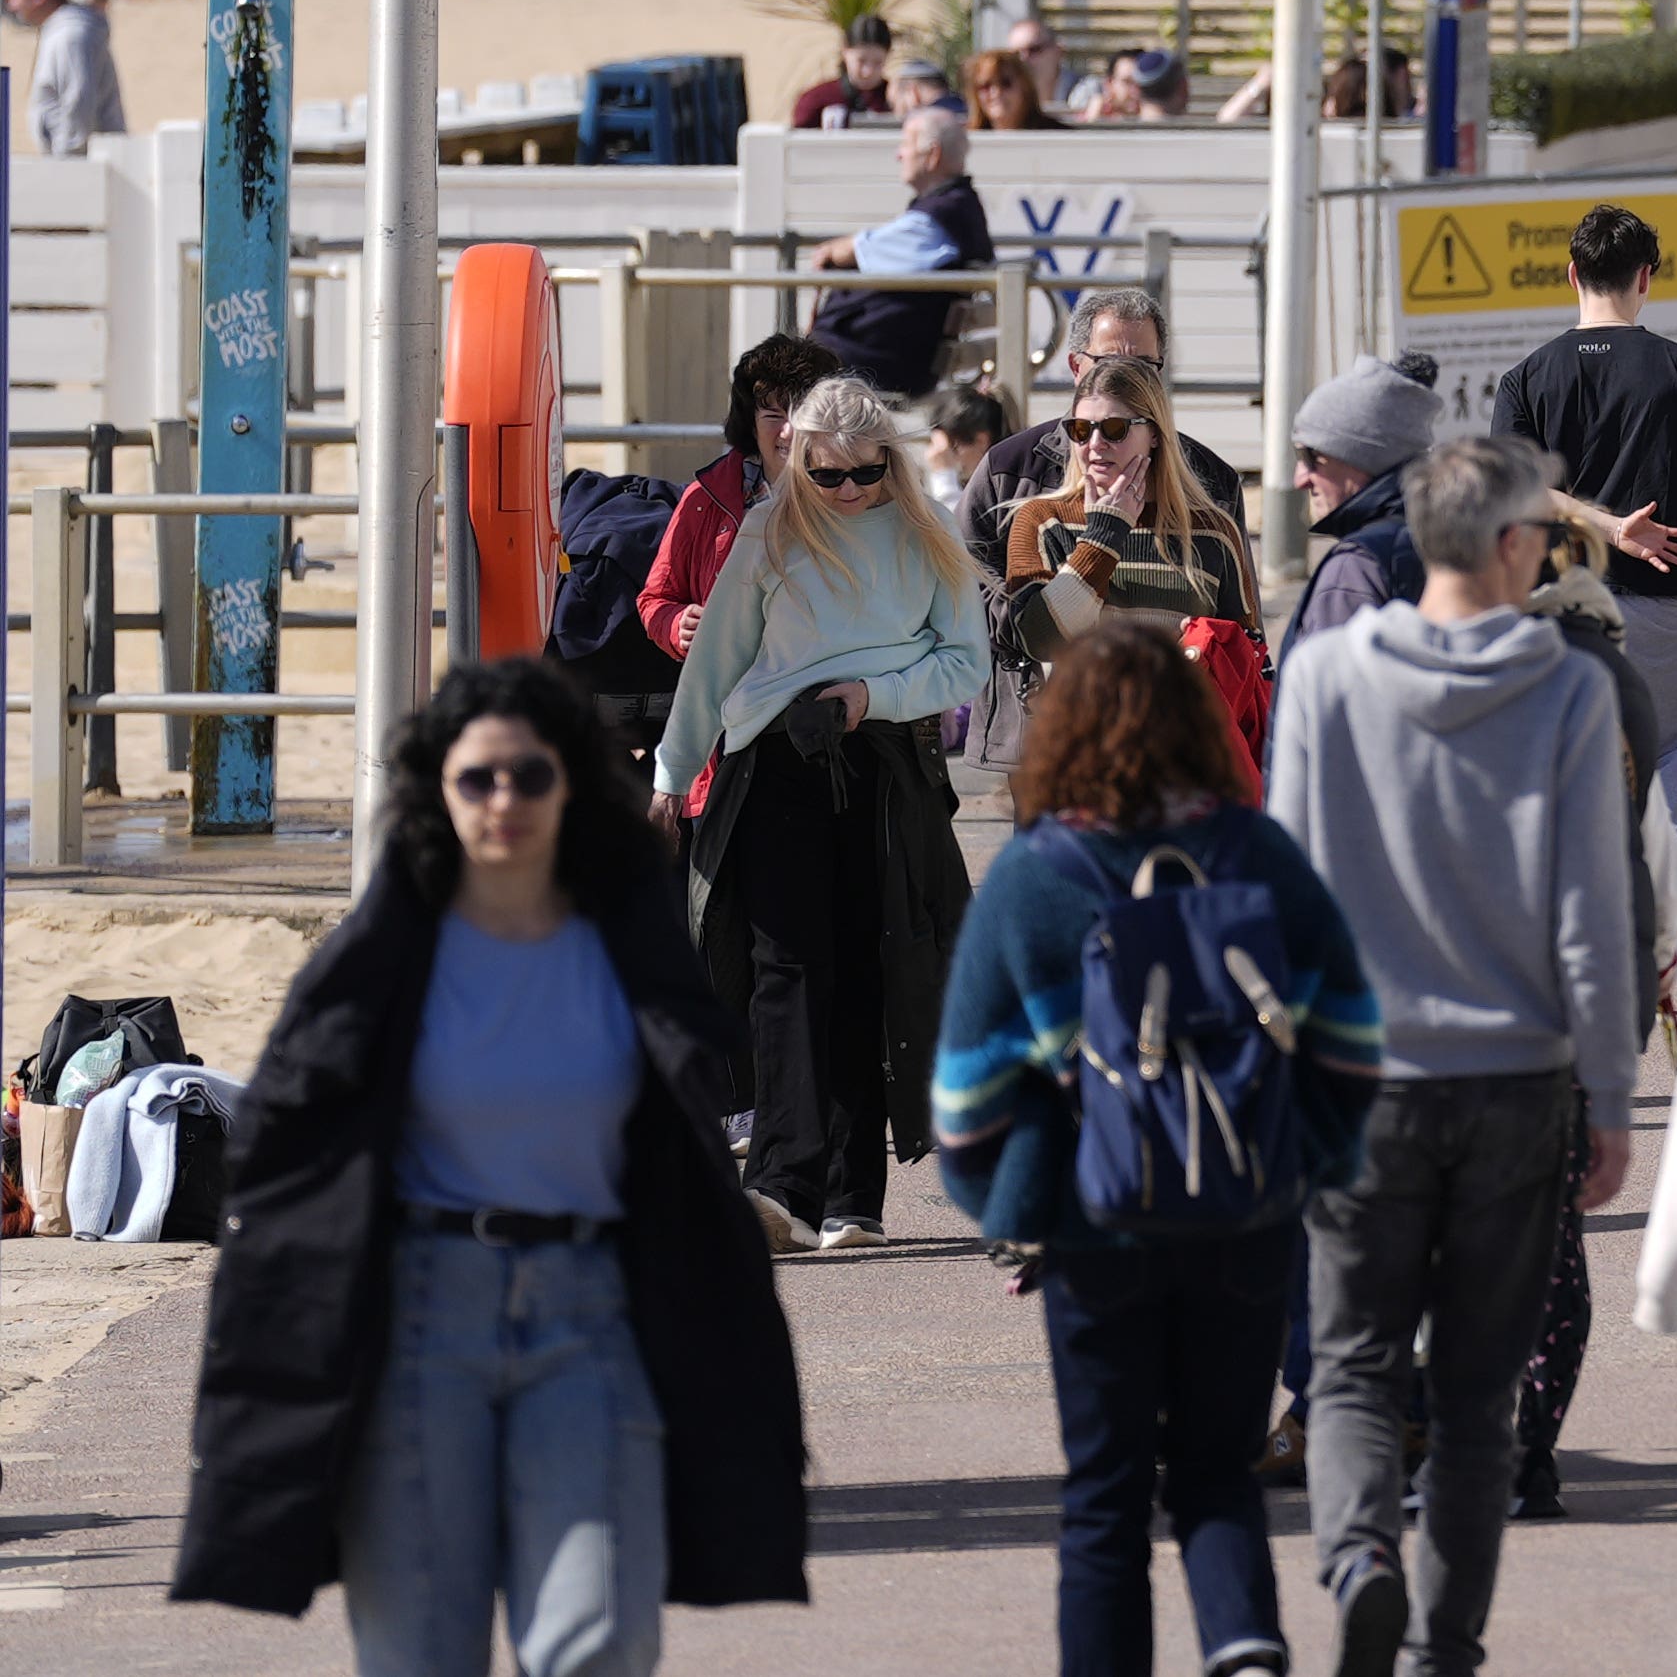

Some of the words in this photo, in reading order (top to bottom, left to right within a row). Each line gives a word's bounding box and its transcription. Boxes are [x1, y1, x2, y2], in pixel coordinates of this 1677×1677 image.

[205, 289, 269, 333] COAST
[220, 331, 278, 368] MOST
[1578, 343, 1611, 352] POLO
